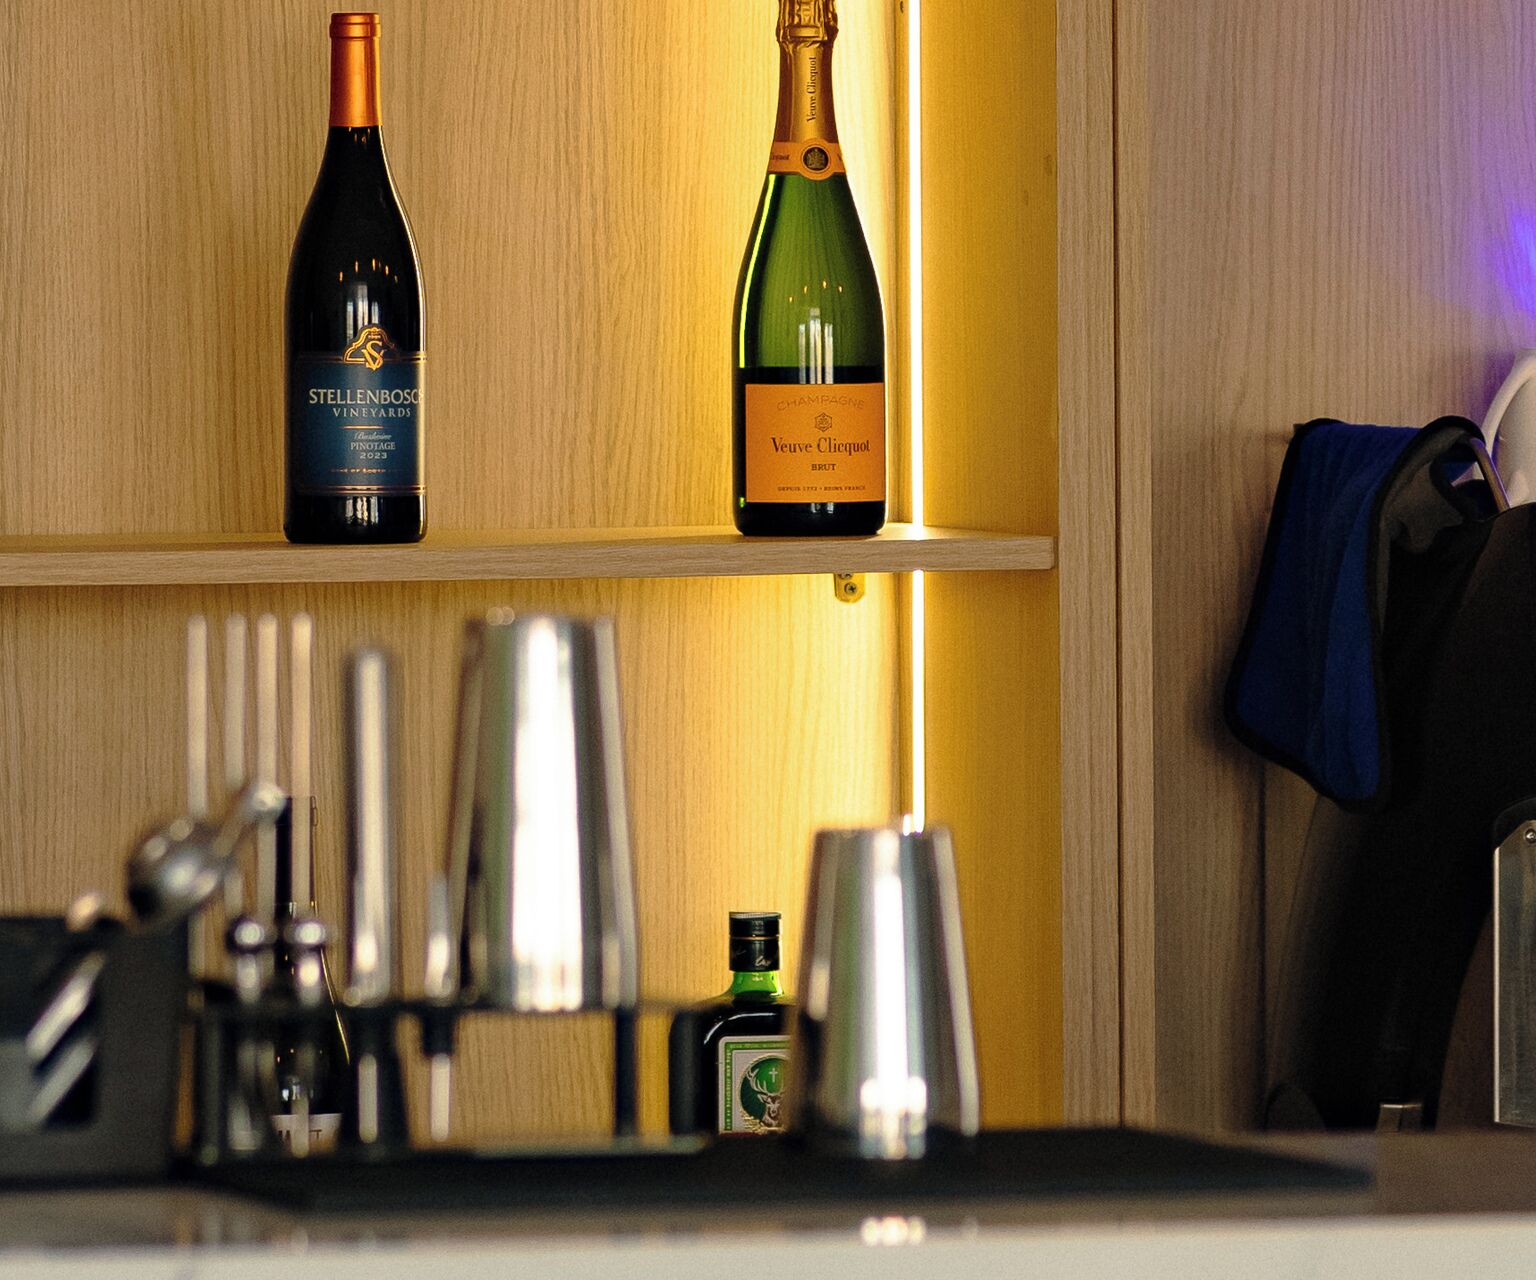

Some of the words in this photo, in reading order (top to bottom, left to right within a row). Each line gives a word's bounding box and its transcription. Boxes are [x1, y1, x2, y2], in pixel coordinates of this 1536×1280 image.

[776, 394, 866, 412] CHAMPAGNE
[332, 407, 412, 418] VINEYARDS
[349, 441, 397, 451] PINOTAGE
[770, 436, 813, 454] Veuve
[816, 436, 871, 457] Clicquot
[359, 452, 389, 460] 2023
[810, 462, 837, 472] BRUT
